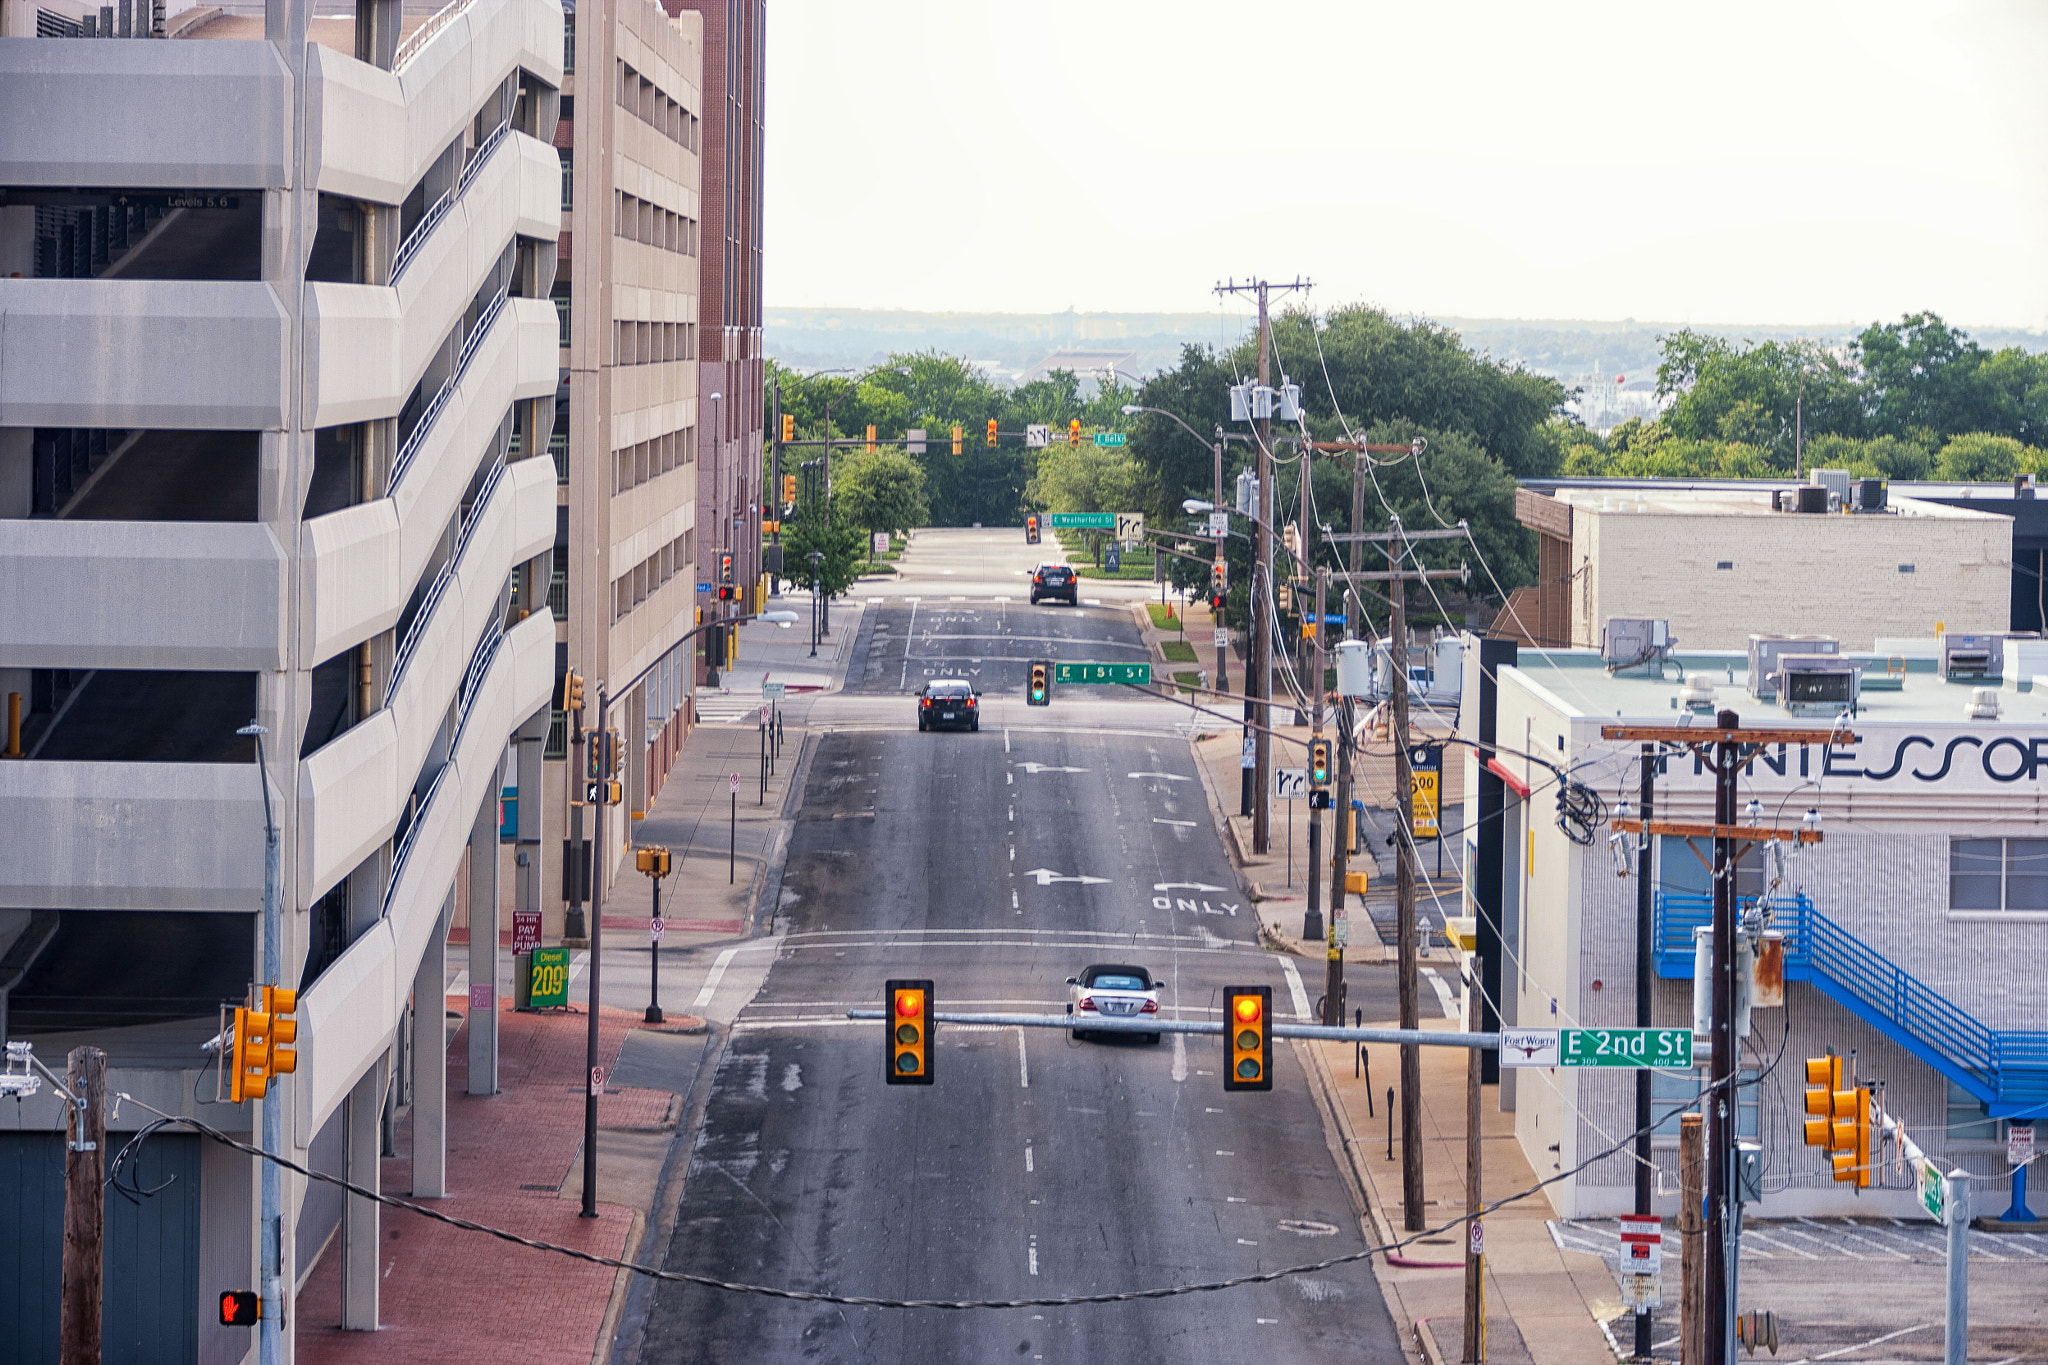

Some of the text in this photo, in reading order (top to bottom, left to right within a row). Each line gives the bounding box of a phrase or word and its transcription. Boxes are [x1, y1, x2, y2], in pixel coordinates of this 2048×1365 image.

[167, 196, 203, 207] Levels
[220, 197, 228, 207] 6
[923, 668, 981, 676] ONLY
[1062, 666, 1071, 678] E
[1126, 667, 1143, 678] St
[1152, 897, 1239, 916] ONLY
[516, 916, 524, 924] 24
[518, 925, 536, 935] PAY
[514, 941, 541, 951] PUMP
[540, 952, 563, 963] Diesel
[1568, 1031, 1582, 1056] E
[1595, 1031, 1646, 1056] 2nd
[1657, 1031, 1686, 1056] St
